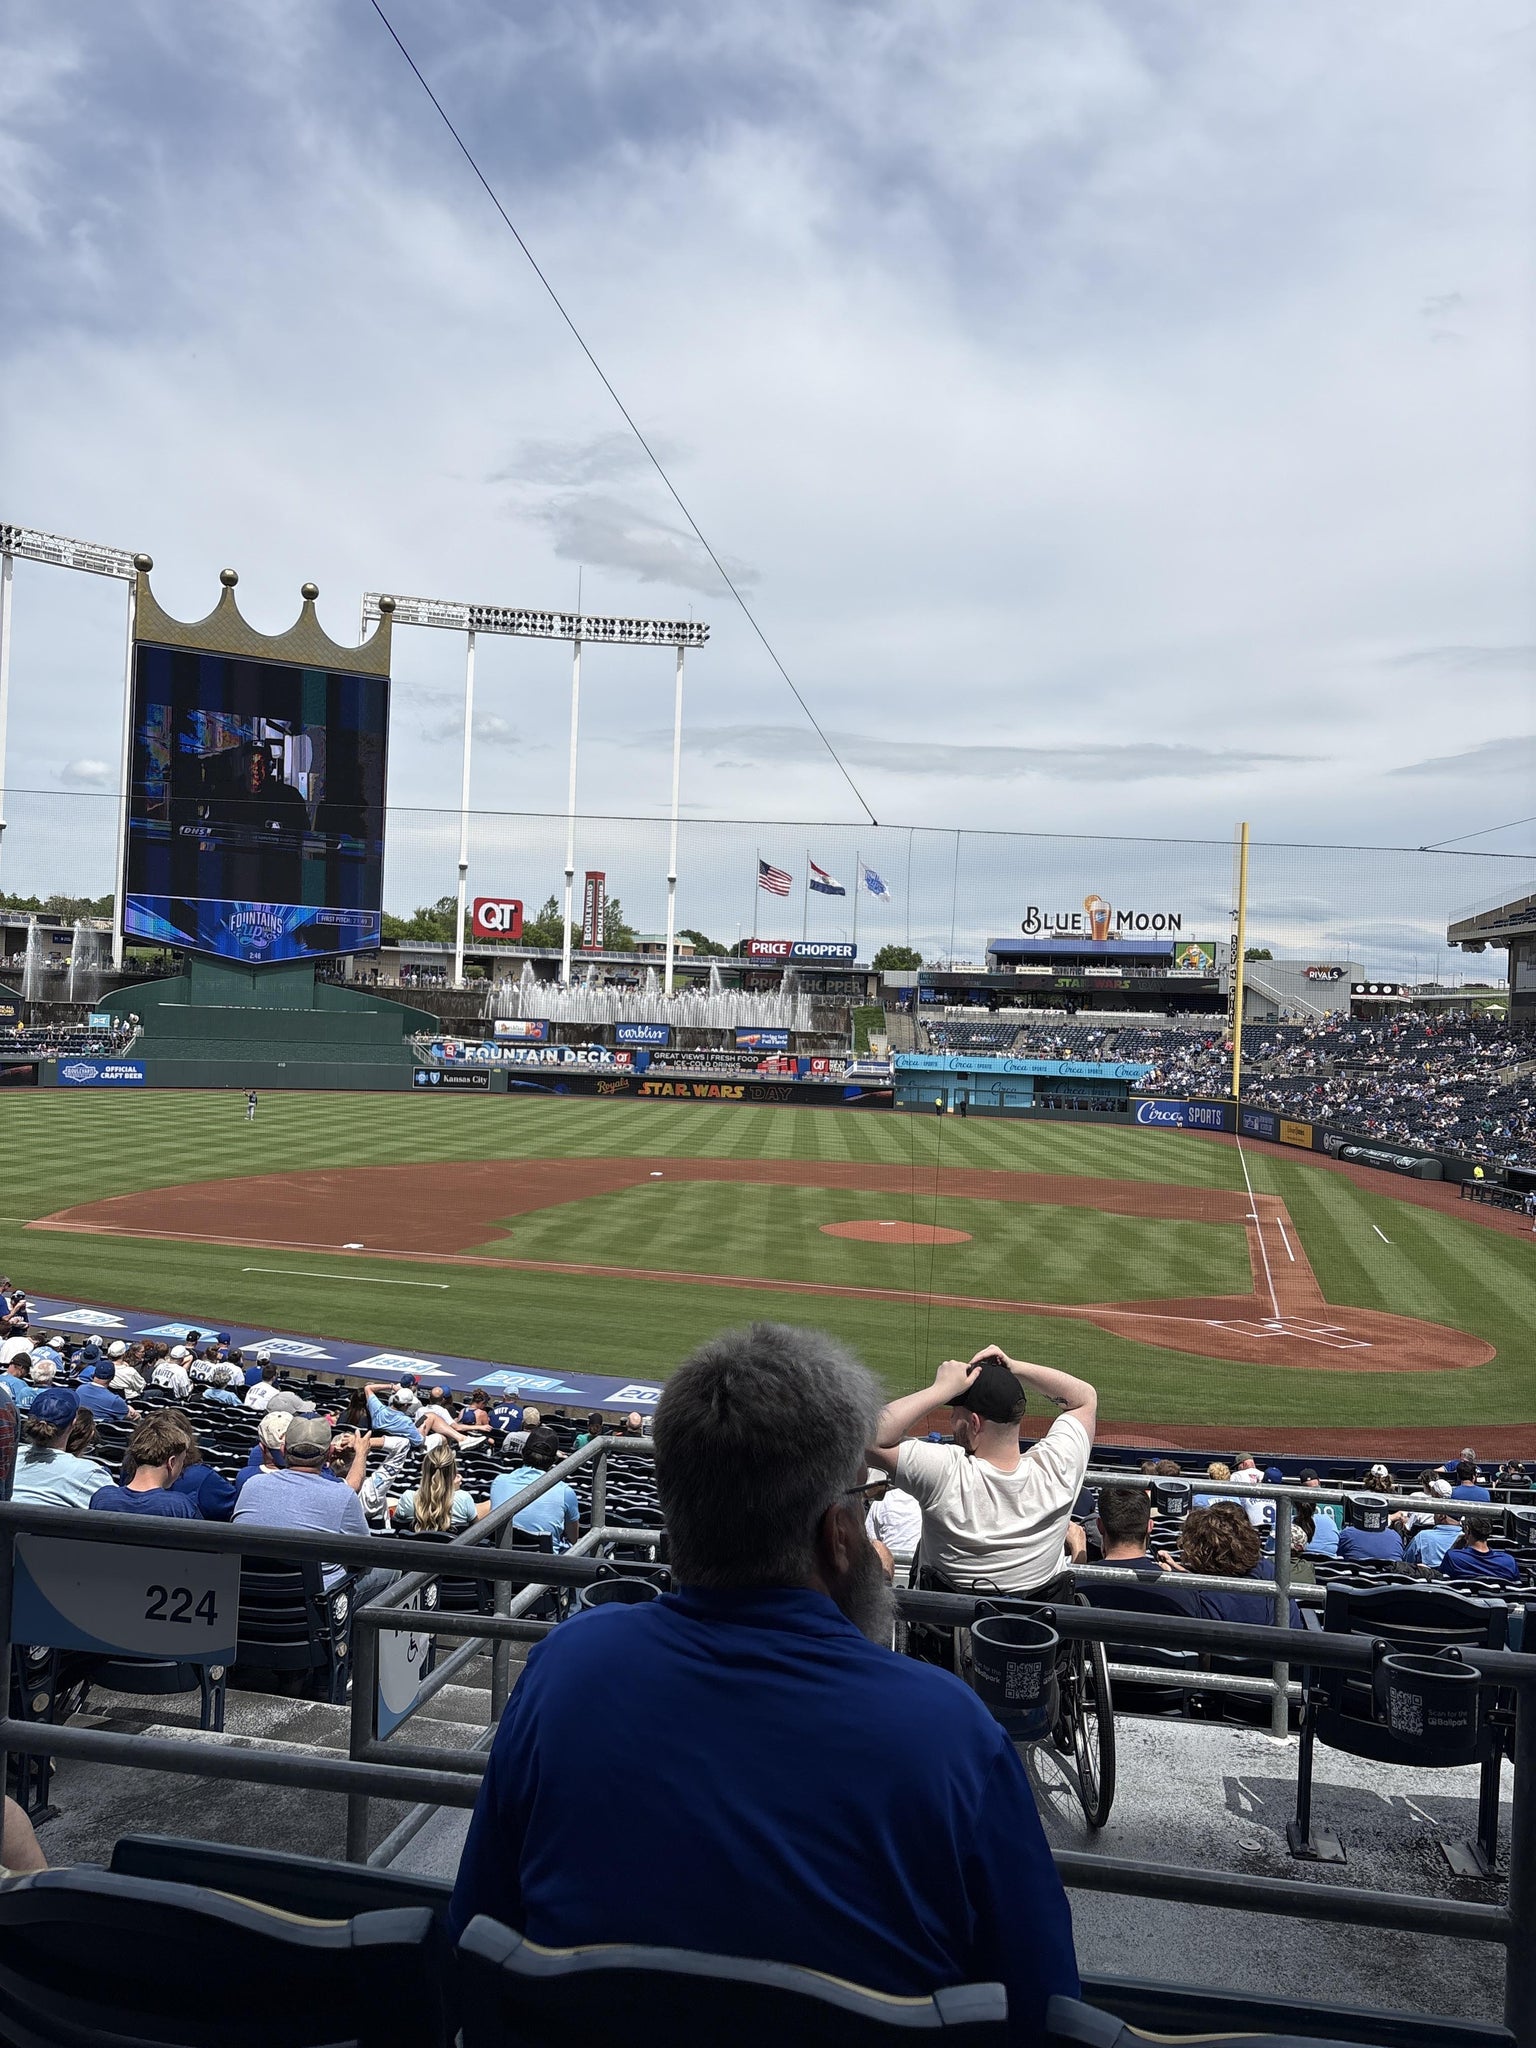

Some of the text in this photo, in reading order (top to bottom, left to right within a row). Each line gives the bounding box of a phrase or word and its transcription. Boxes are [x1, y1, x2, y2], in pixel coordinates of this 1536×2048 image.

[478, 902, 516, 932] QT
[585, 884, 594, 941] BOULEVARD
[230, 911, 283, 934] FOUNTAINS
[1021, 906, 1182, 935] BLUE MOON
[751, 942, 852, 957] PRICE CHOPPER
[1309, 970, 1339, 980] RIVALS
[465, 1047, 558, 1061] FOUNTAIN
[564, 1050, 613, 1063] DECK
[681, 1053, 705, 1061] VIEWS
[711, 1054, 736, 1062] FRESH
[737, 1055, 759, 1063] FOOD
[712, 1061, 741, 1069] DRINKS
[812, 1060, 826, 1070] QT
[1003, 1059, 1028, 1072] Circa
[1058, 1062, 1083, 1075] Circa
[1114, 1064, 1139, 1078] Circa
[443, 1074, 488, 1085] Kansas City
[596, 1077, 793, 1101] Royals STAR WARS DAY
[1137, 1101, 1221, 1125] Circa SPORTS
[261, 1340, 314, 1354] 1981
[366, 1356, 435, 1372] 1984
[484, 1374, 551, 1389] 2014
[498, 1416, 511, 1430] 7
[1262, 1505, 1275, 1523] 9
[144, 1584, 219, 1626] 224
[1428, 1709, 1446, 1717] Scan
[1437, 1717, 1467, 1728] Ballpark
